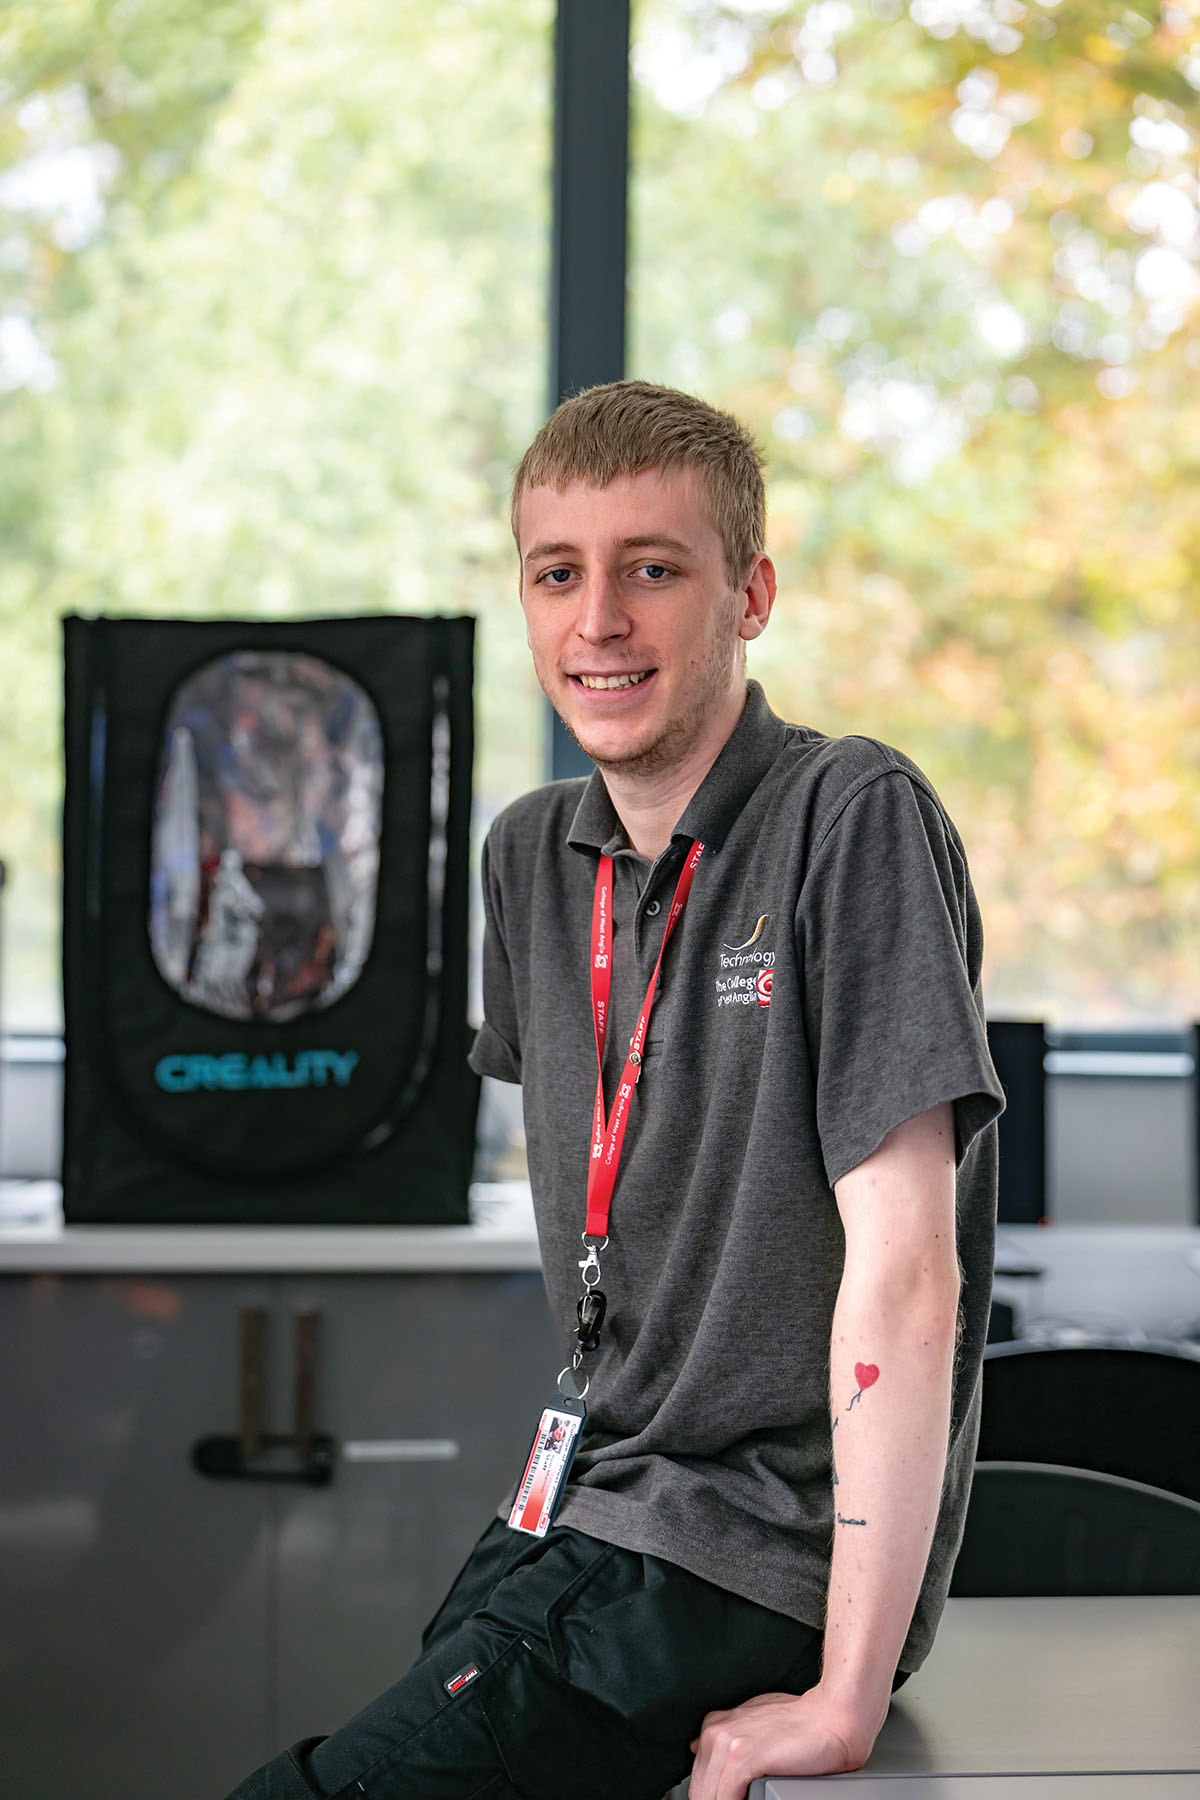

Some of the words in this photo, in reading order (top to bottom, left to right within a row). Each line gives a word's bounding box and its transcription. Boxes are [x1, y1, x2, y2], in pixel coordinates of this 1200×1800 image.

[690, 843, 705, 870] STAF
[634, 1016, 646, 1050] STAFF
[154, 1049, 359, 1093] CREALITY
[605, 1143, 616, 1165] College
